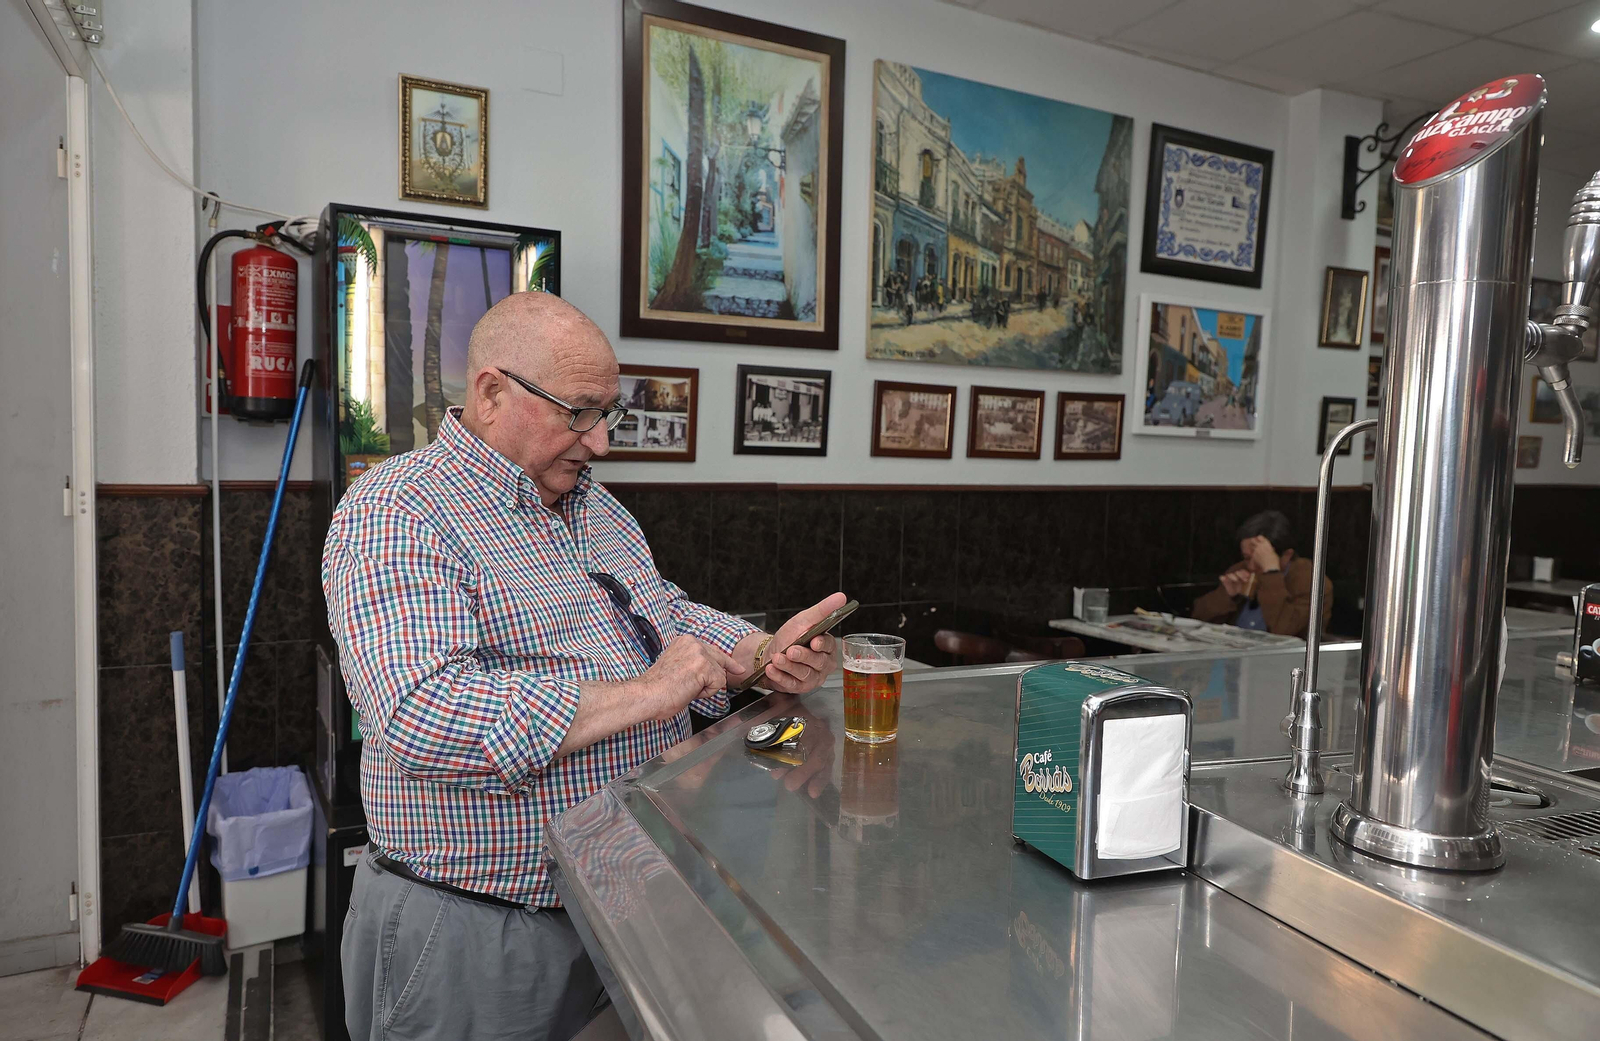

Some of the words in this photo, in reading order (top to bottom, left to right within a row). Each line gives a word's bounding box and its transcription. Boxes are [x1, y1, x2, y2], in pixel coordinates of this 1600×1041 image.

[1404, 106, 1526, 148] ruzcampo
[250, 355, 295, 372] RUCA
[1034, 749, 1053, 765] Café
[1020, 753, 1073, 793] Borrás
[1039, 791, 1056, 806] Desde
[1054, 799, 1071, 813] 1909
